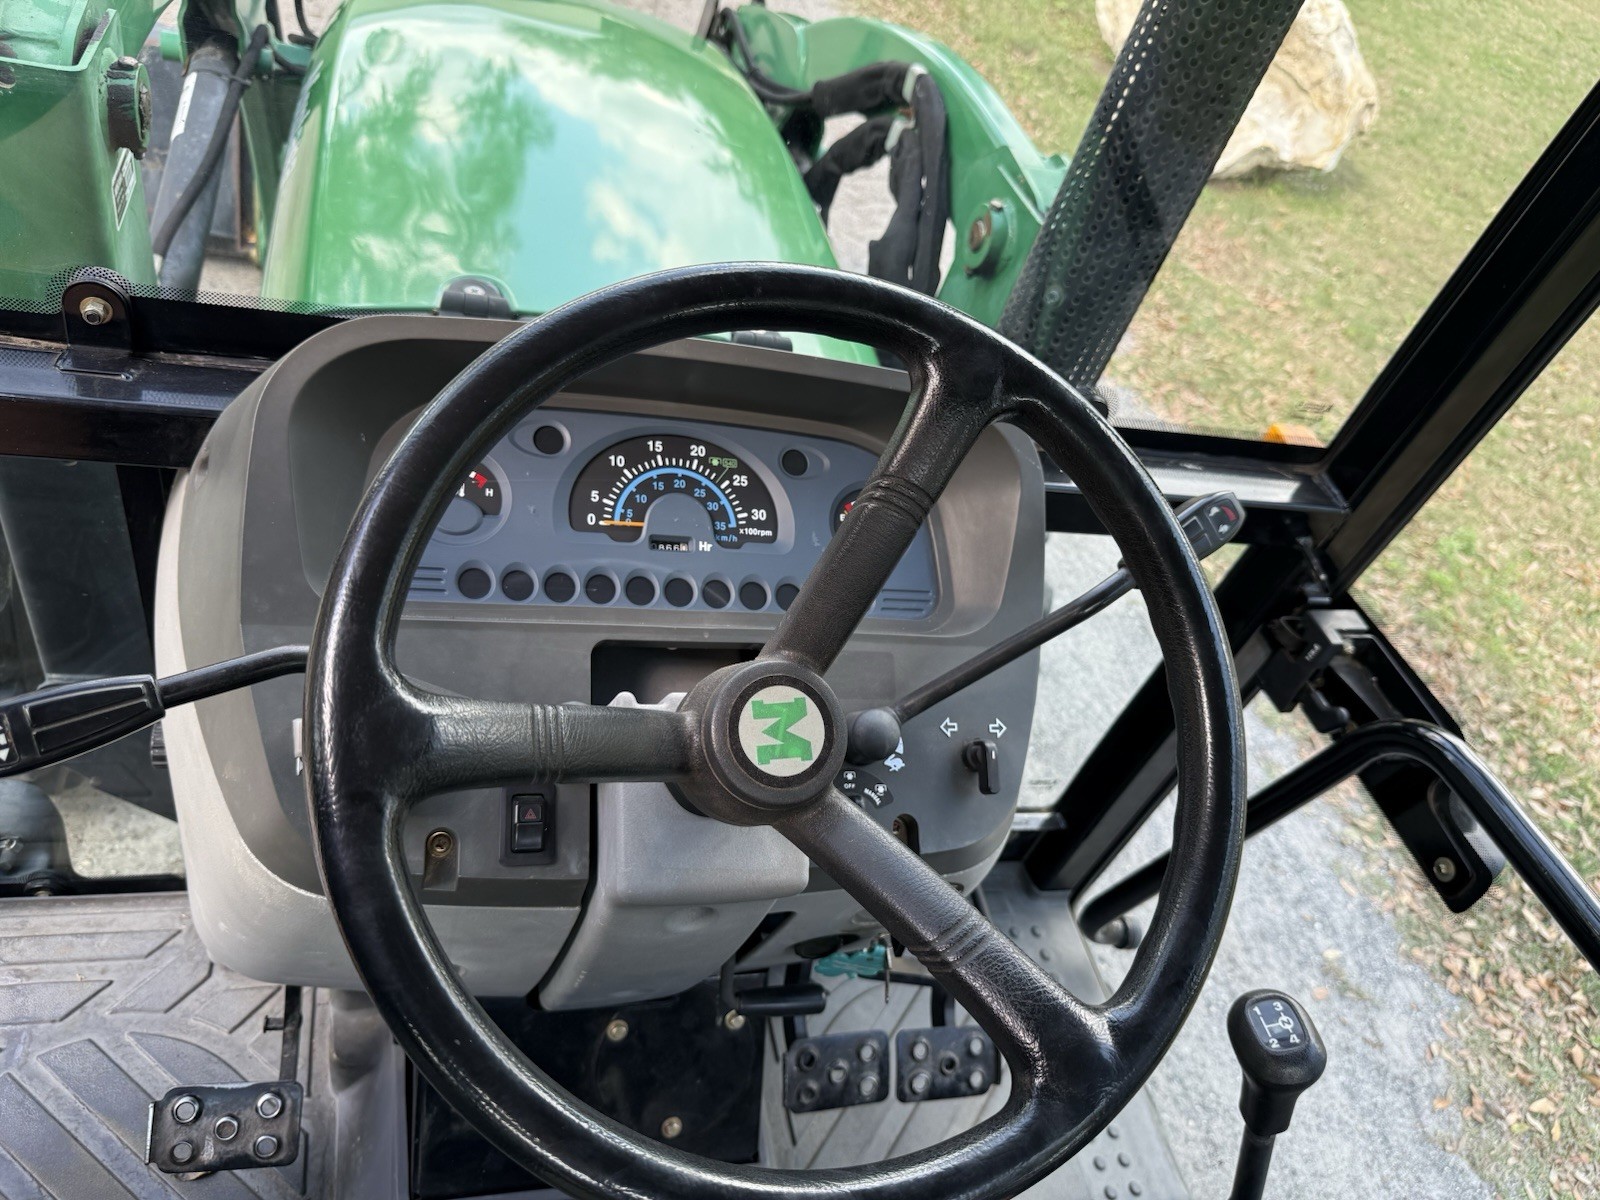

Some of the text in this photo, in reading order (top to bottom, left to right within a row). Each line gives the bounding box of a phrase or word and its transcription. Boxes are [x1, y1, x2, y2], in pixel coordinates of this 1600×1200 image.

[647, 440, 663, 452] 15
[689, 444, 706, 457] 20
[608, 455, 625, 468] 10
[673, 479, 686, 489] 20
[732, 474, 748, 487] 25
[653, 481, 664, 491] 15
[590, 490, 600, 502] 5
[693, 488, 706, 498] 25
[635, 494, 648, 504] 10
[706, 502, 719, 512] 30
[626, 509, 633, 518] 5
[751, 509, 767, 521] 30
[587, 514, 596, 525] 0
[715, 522, 726, 531] 35
[699, 541, 713, 552] Hr
[751, 697, 813, 765] M
[1253, 1006, 1261, 1015] 1
[1273, 1002, 1283, 1011] 3
[1269, 1039, 1279, 1048] 2
[1290, 1034, 1300, 1043] 4
